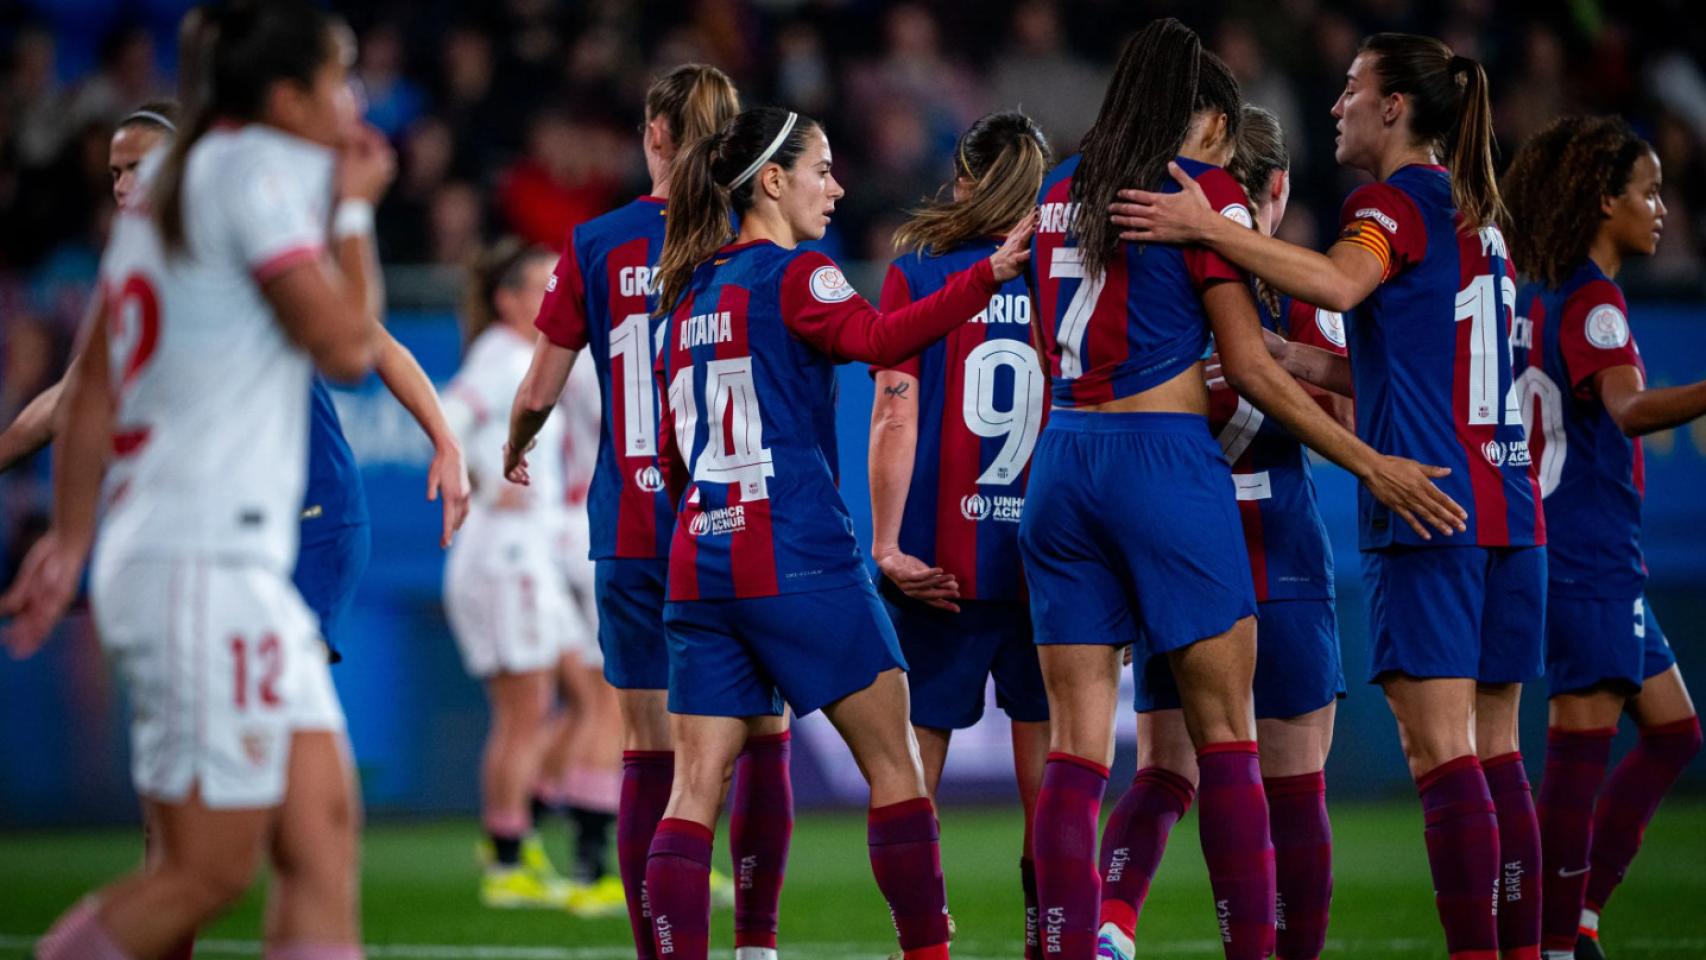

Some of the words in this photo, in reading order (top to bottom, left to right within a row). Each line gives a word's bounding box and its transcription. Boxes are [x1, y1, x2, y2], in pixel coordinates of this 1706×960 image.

[680, 312, 733, 351] AITANA
[1050, 248, 1107, 380] 7
[668, 356, 775, 503] 14
[963, 339, 1045, 485] 9
[711, 505, 745, 521] UNHCR
[993, 496, 1025, 507] UNH
[993, 507, 1022, 518] ACN
[713, 516, 746, 531] ACNUR
[229, 634, 284, 709] 12
[1106, 847, 1130, 882] BARÇA
[1505, 860, 1524, 902] BARÇA
[656, 914, 674, 954] BARÇA
[1046, 906, 1065, 953] BARÇA
